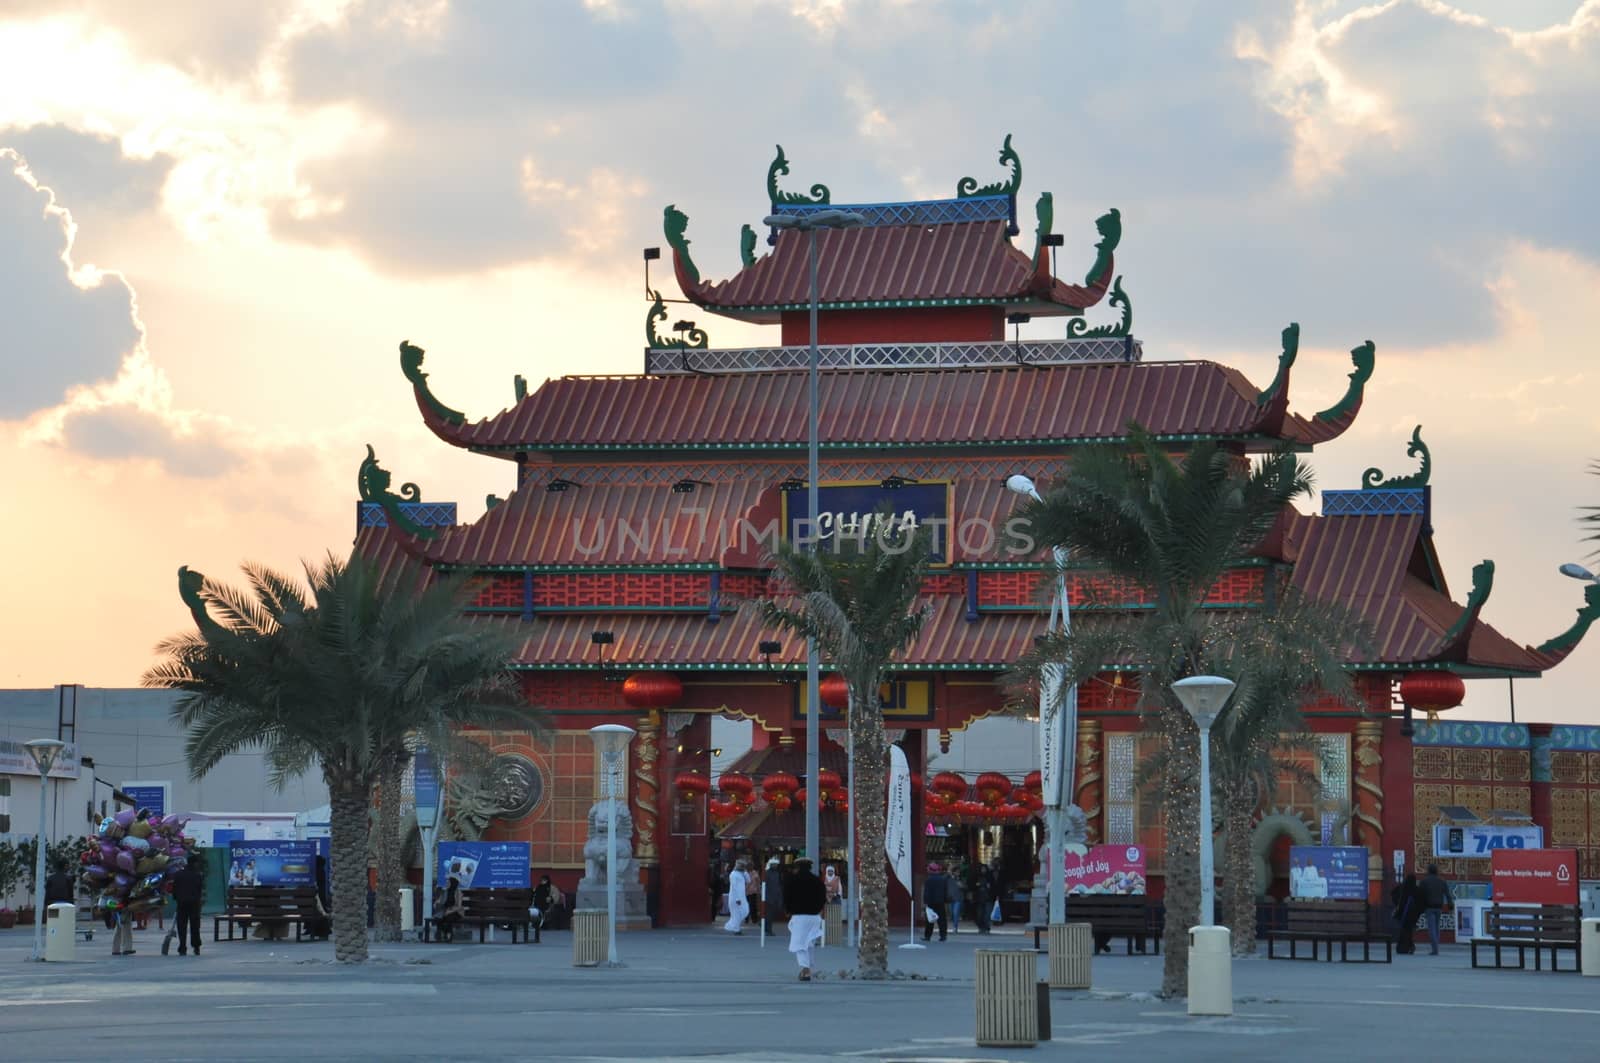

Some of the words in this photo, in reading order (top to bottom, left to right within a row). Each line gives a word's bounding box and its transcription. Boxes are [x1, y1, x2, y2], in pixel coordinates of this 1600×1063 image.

[816, 509, 920, 539] CHINA
[1473, 834, 1525, 853] 749
[1086, 861, 1095, 874] of
[1095, 859, 1110, 873] Joy
